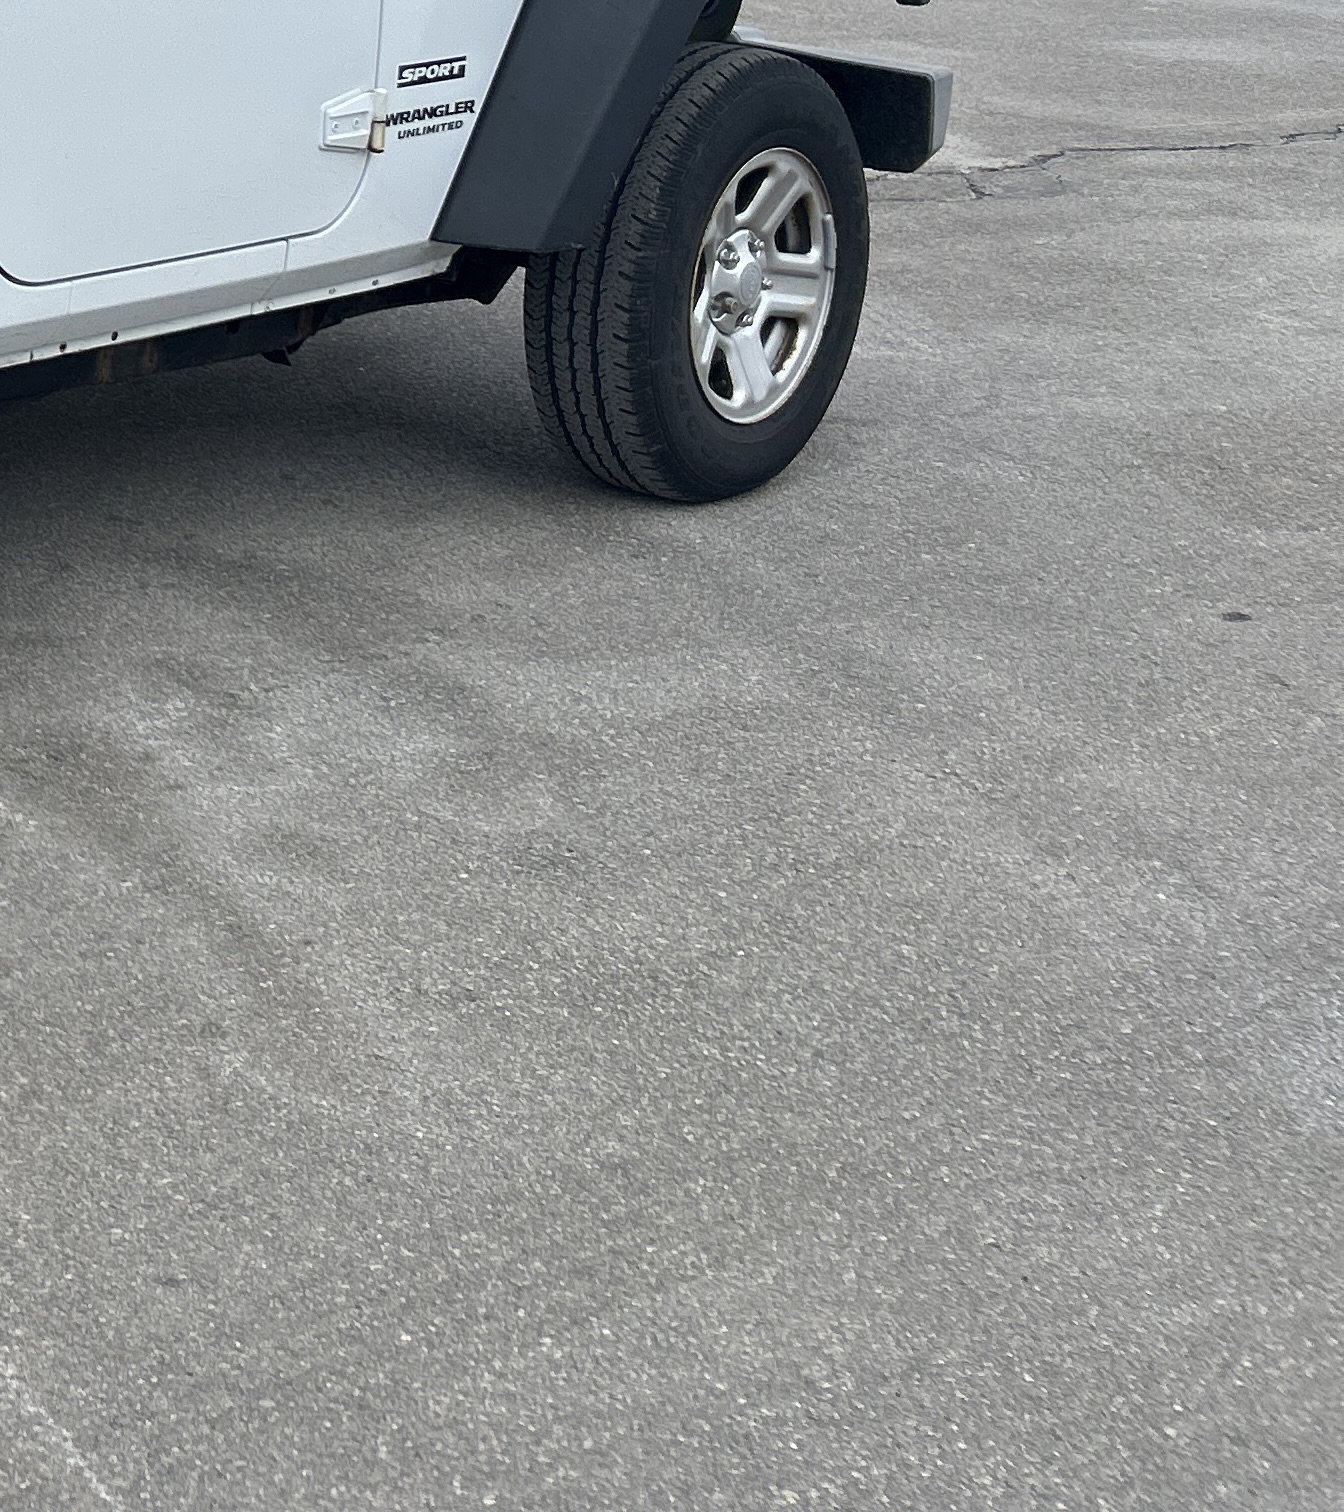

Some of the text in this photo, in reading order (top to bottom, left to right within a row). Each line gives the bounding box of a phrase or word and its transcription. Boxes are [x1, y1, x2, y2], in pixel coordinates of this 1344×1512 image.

[399, 62, 466, 84] SPORT
[385, 99, 475, 127] WRANGLER
[397, 120, 464, 139] UNLIMITED
